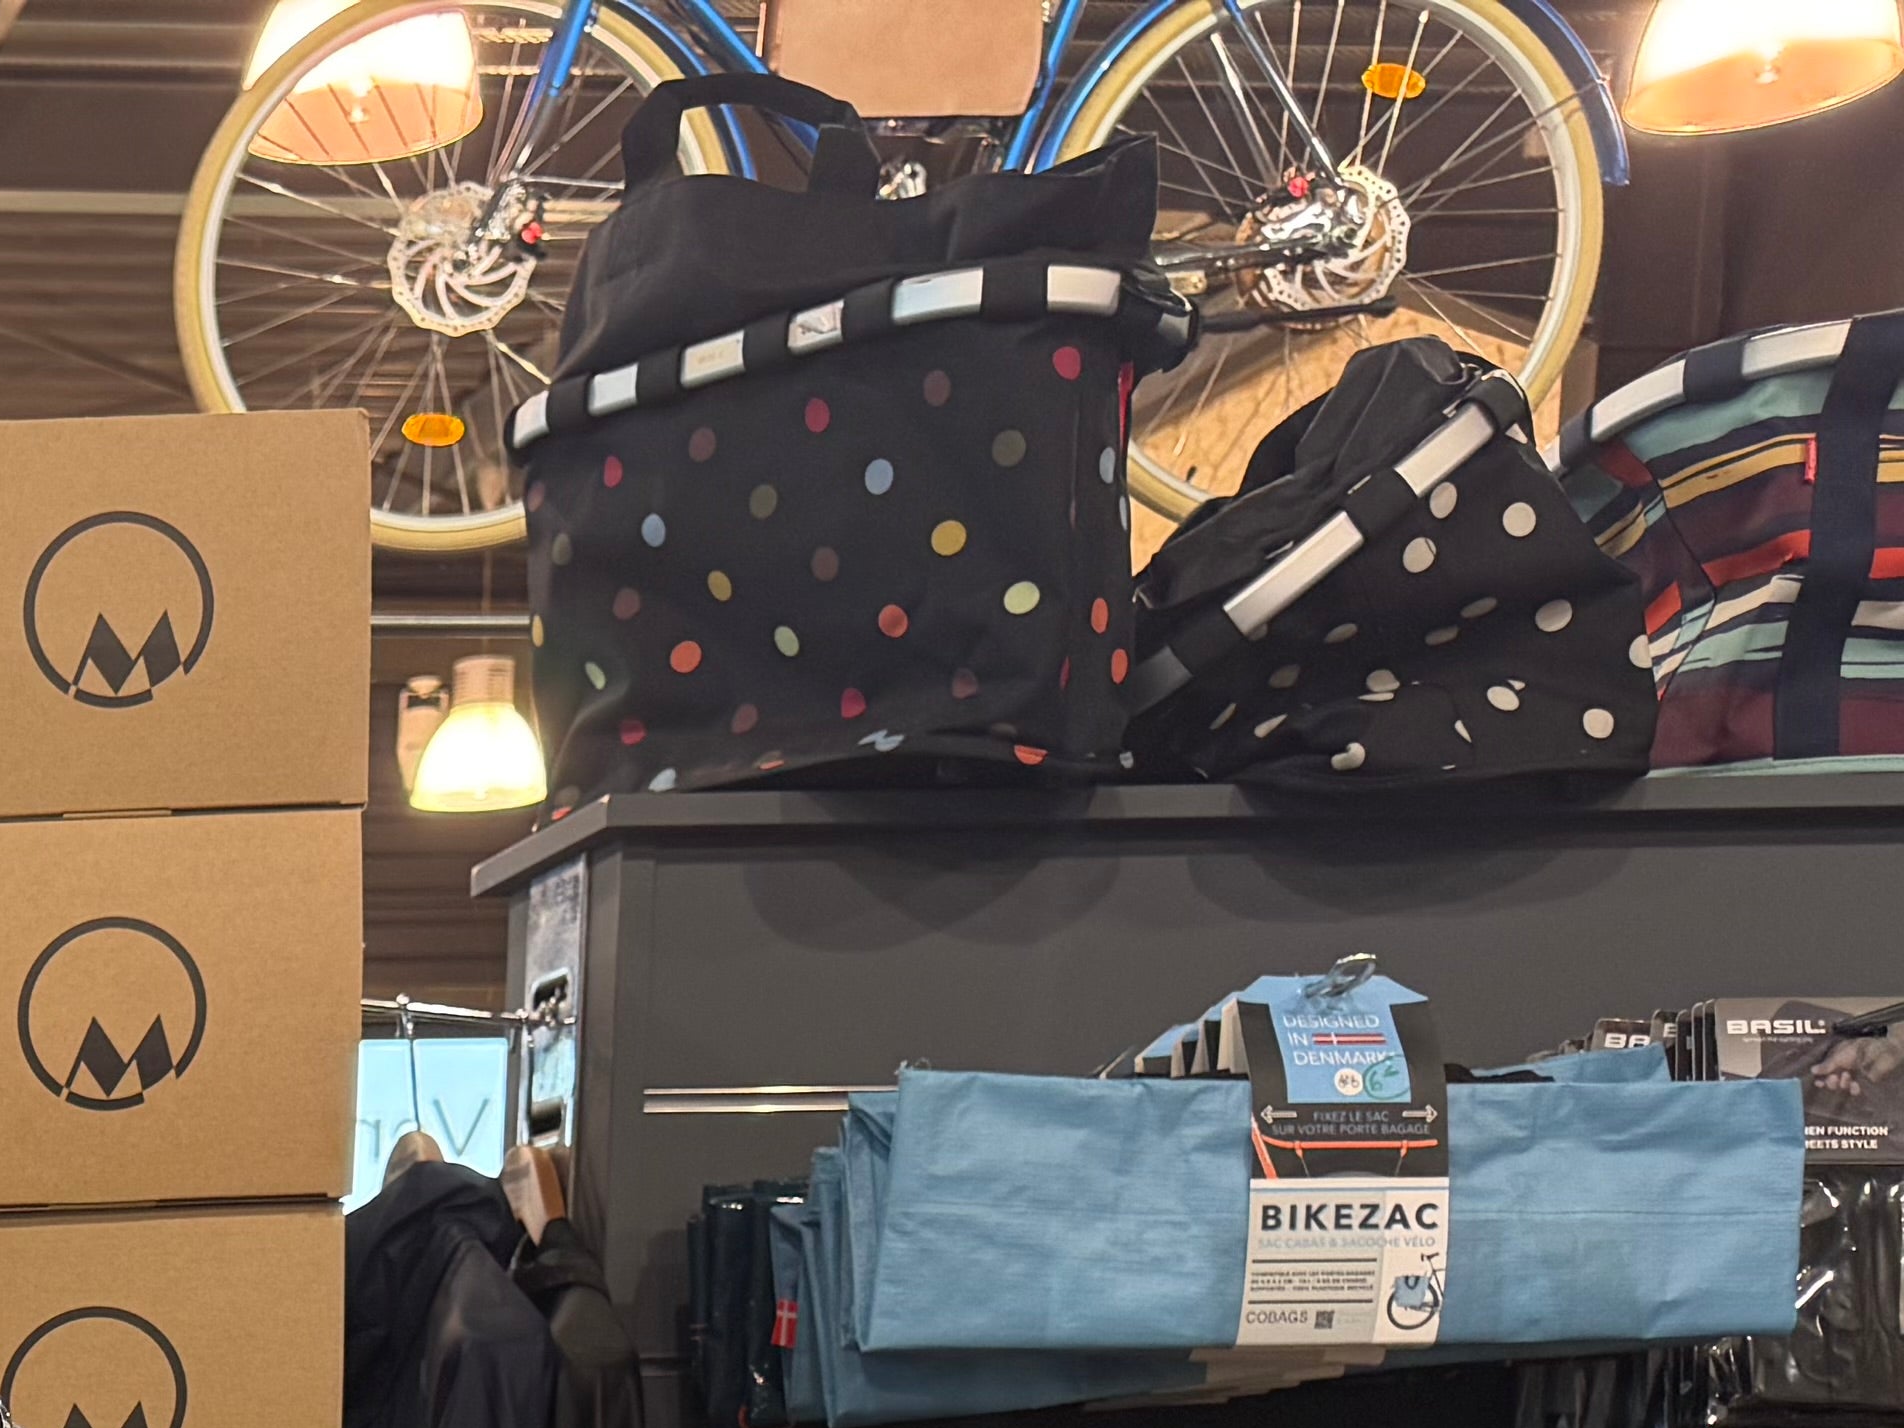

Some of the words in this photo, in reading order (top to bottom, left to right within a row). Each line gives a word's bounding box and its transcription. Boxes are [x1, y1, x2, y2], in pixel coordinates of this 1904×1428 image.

[1283, 1014, 1380, 1029] DESIGNED
[1727, 1019, 1826, 1035] BASIL
[1288, 1032, 1308, 1046] IN
[1313, 1111, 1346, 1123] FIXEZ
[1349, 1111, 1363, 1123] LE
[1366, 1110, 1389, 1122] SAC
[1272, 1126, 1295, 1136] SUR
[1298, 1125, 1336, 1135] VOTRE
[1339, 1124, 1377, 1134] PORTE
[1381, 1123, 1431, 1134] BAGAGE
[1827, 1126, 1889, 1137] FUNCTION
[1841, 1138, 1878, 1149] STYLE
[1261, 1203, 1439, 1231] BIKEZAC
[1404, 1234, 1436, 1247] VÉLO
[1246, 1310, 1308, 1324] COBAGS
